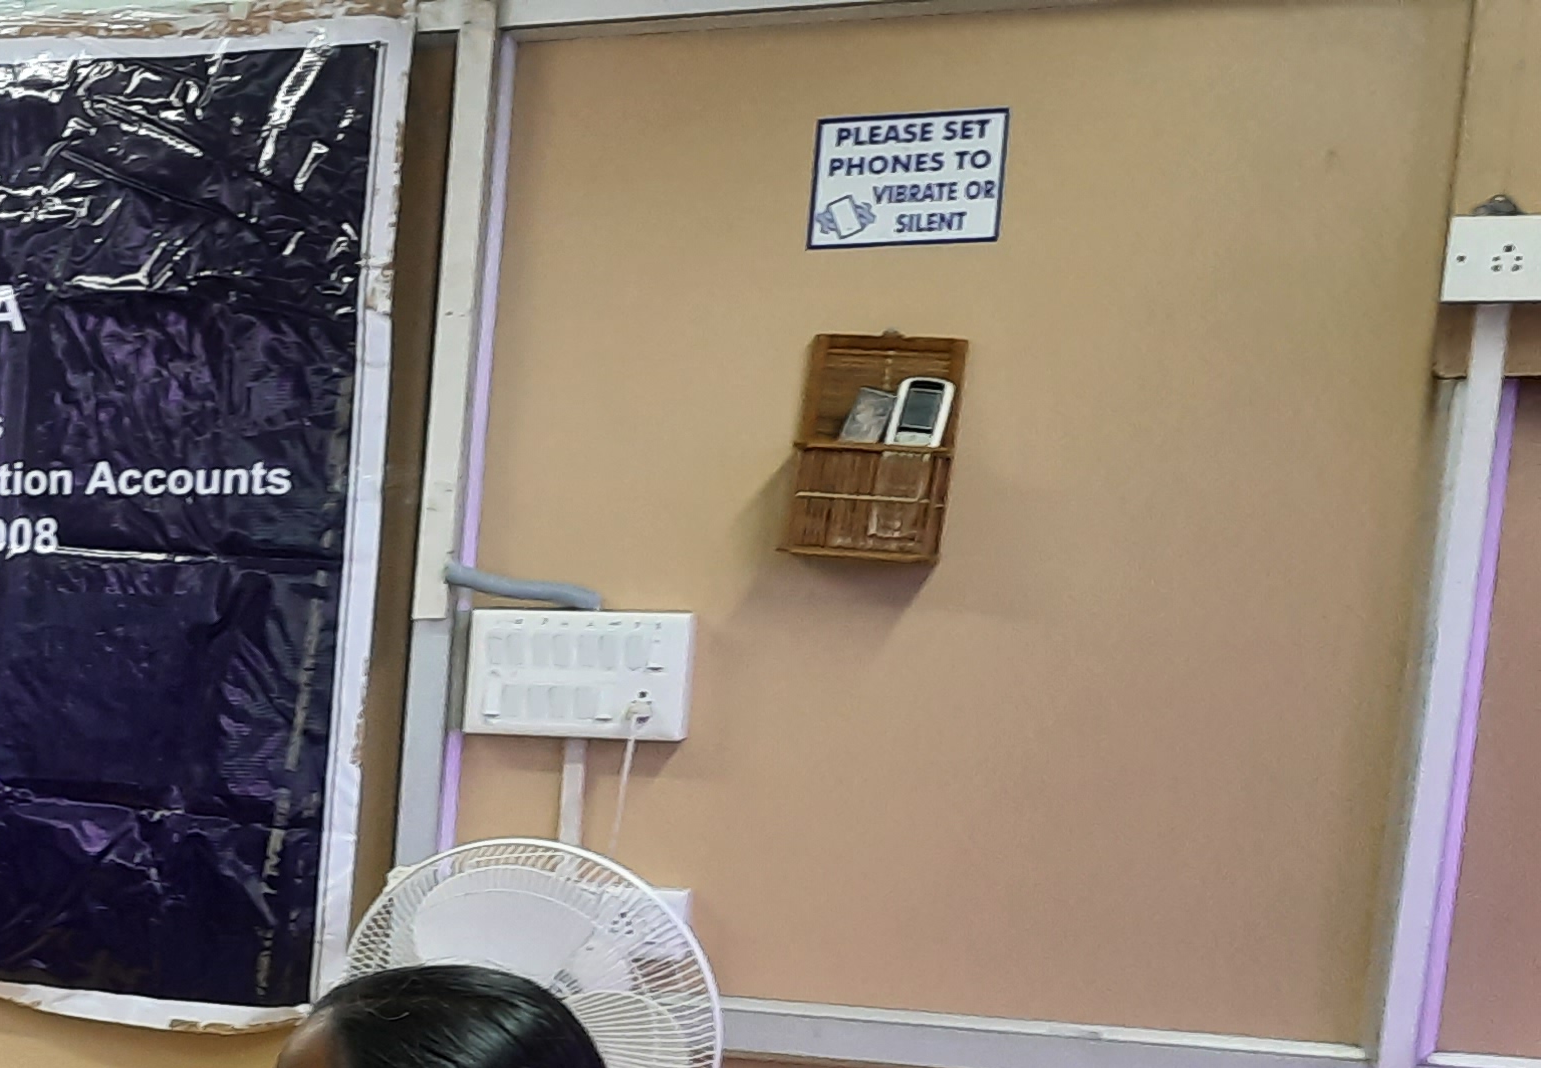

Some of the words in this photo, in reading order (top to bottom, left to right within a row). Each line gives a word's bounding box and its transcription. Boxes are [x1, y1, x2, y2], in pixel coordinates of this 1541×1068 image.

[835, 122, 934, 147] PLEASE
[942, 119, 992, 141] SET
[828, 152, 945, 177] PHONES
[955, 149, 992, 170] TO
[872, 182, 958, 204] VIBRATE
[964, 179, 996, 200] OR
[893, 211, 967, 233] SILENT
[84, 460, 293, 496] Accounts
